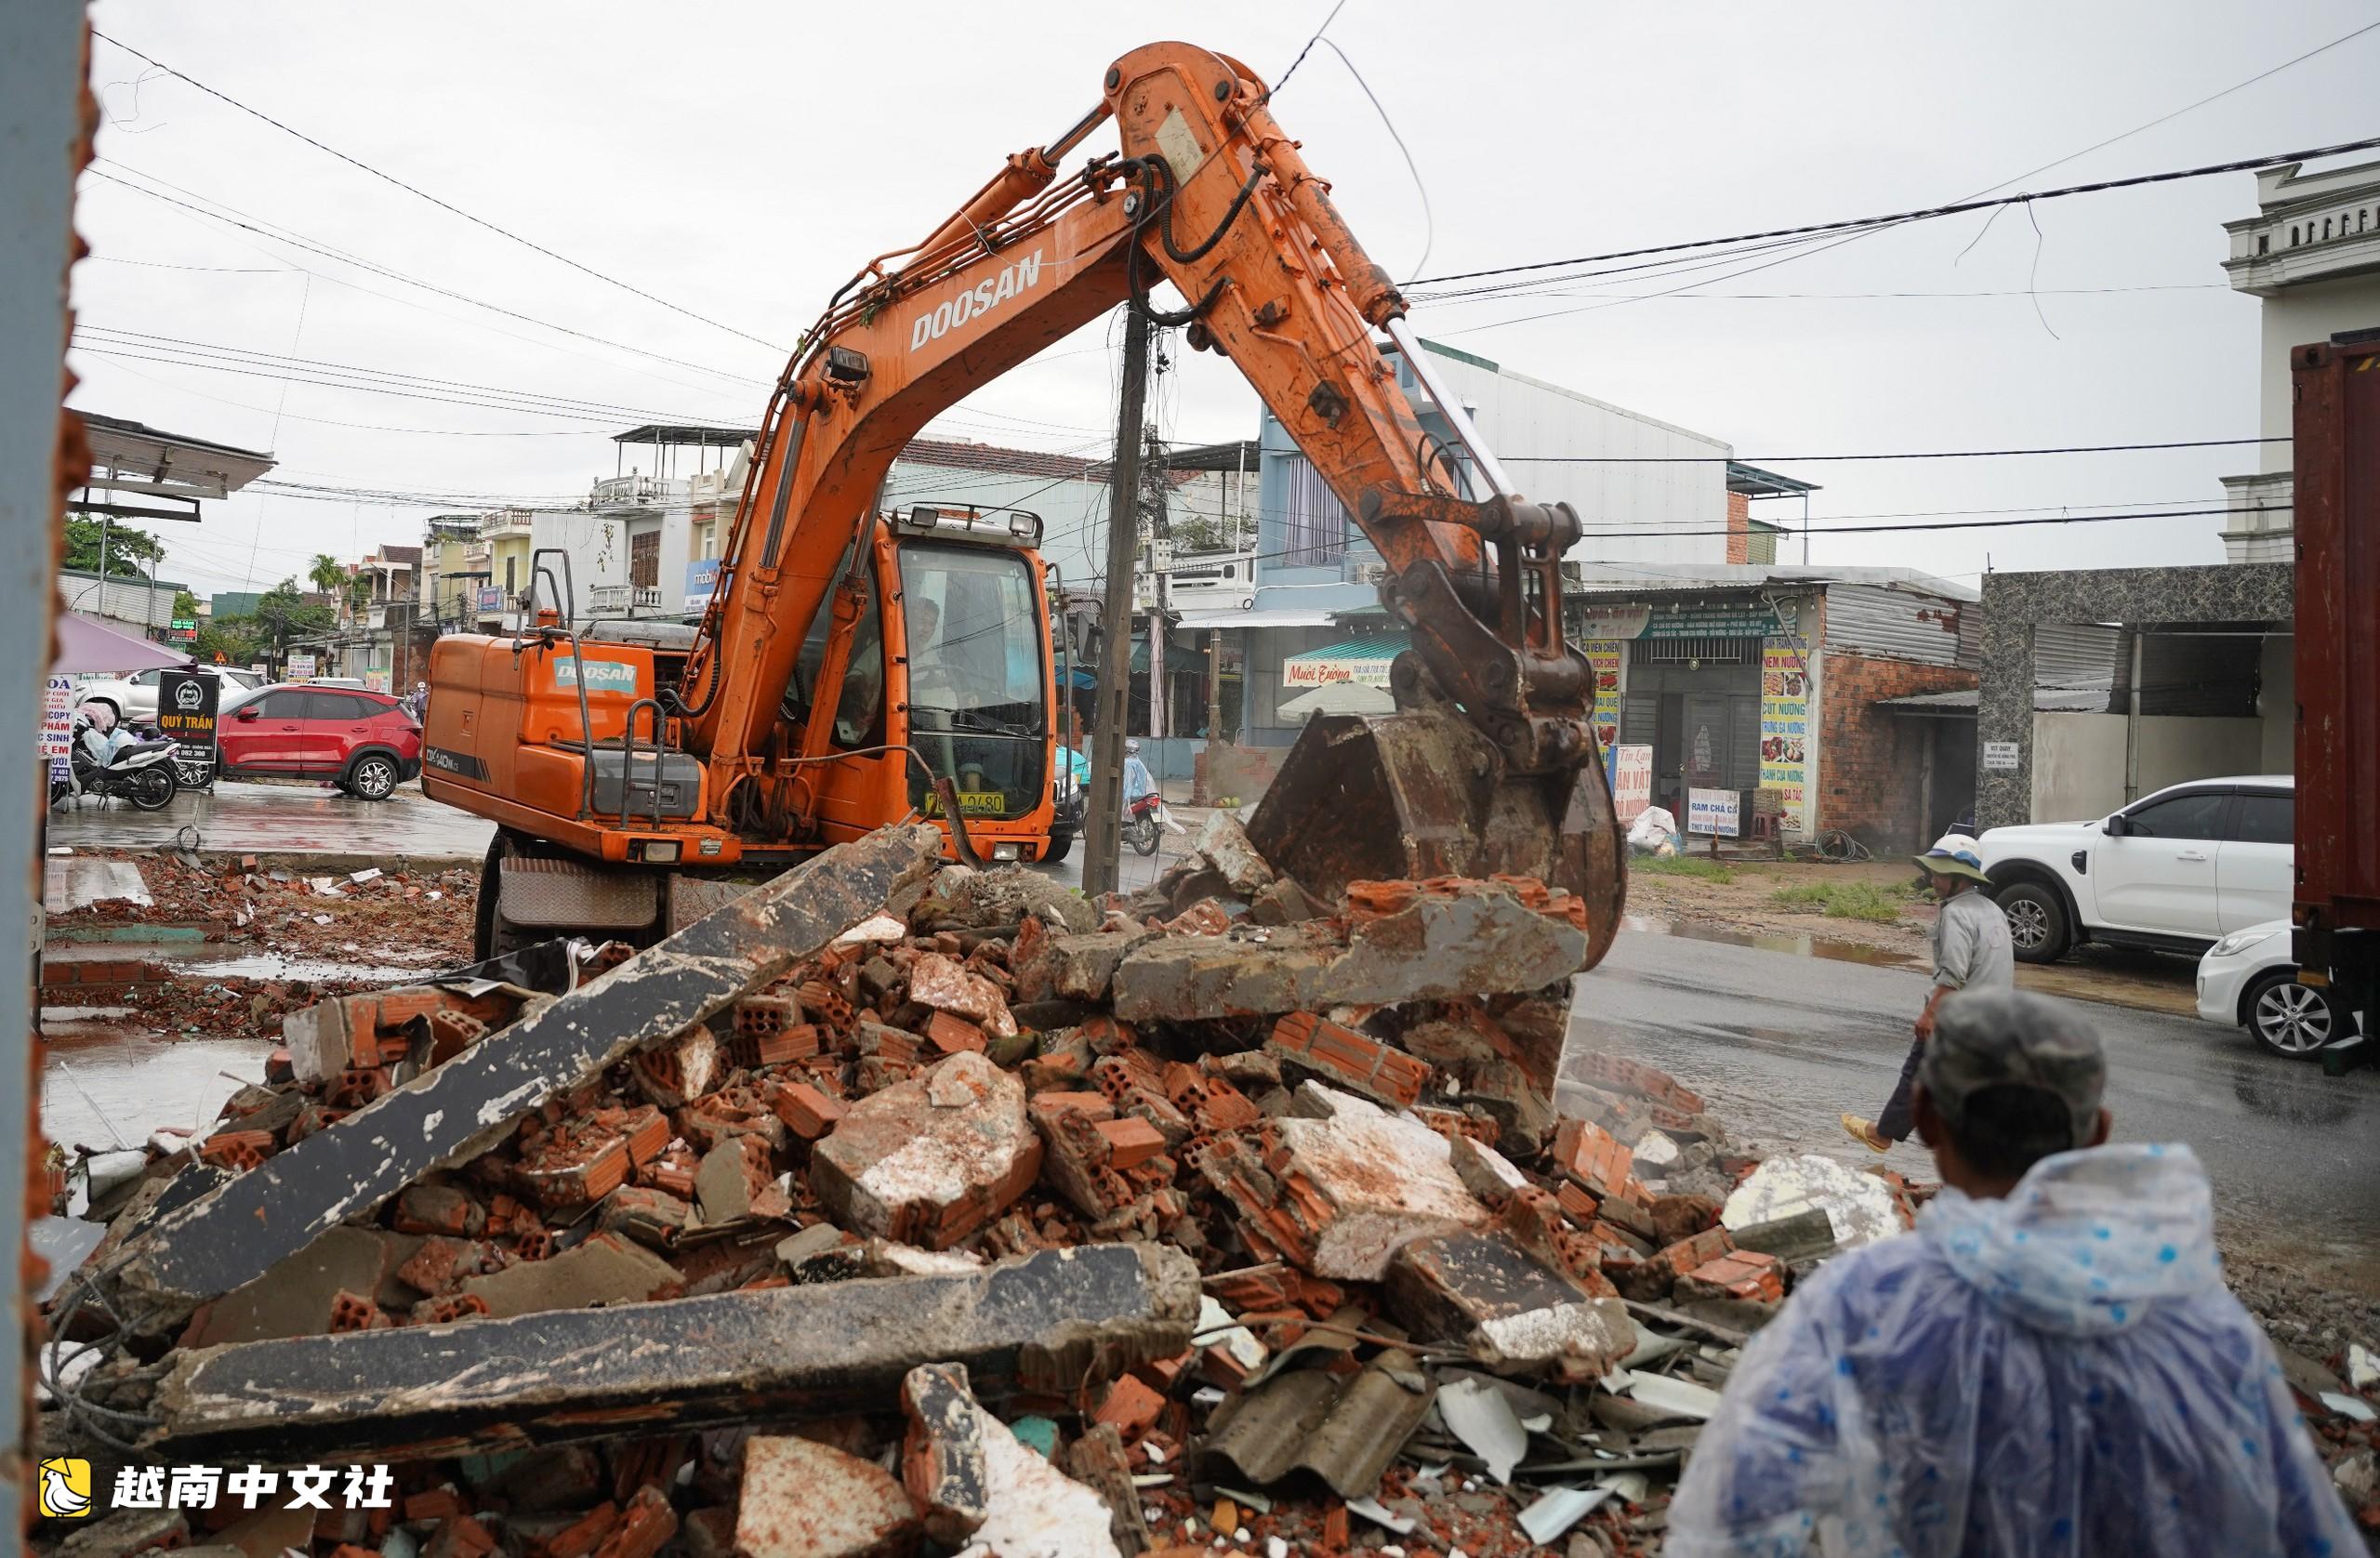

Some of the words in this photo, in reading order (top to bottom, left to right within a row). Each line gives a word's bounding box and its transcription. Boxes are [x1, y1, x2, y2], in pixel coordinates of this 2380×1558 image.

[910, 247, 1042, 352] DOOSAN
[161, 713, 183, 729] QUÝ
[46, 733, 70, 743] SINH
[51, 746, 69, 755] EM
[1617, 768, 1631, 790] ĂN
[1633, 767, 1651, 794] VẶT
[1691, 802, 1708, 812] RAM
